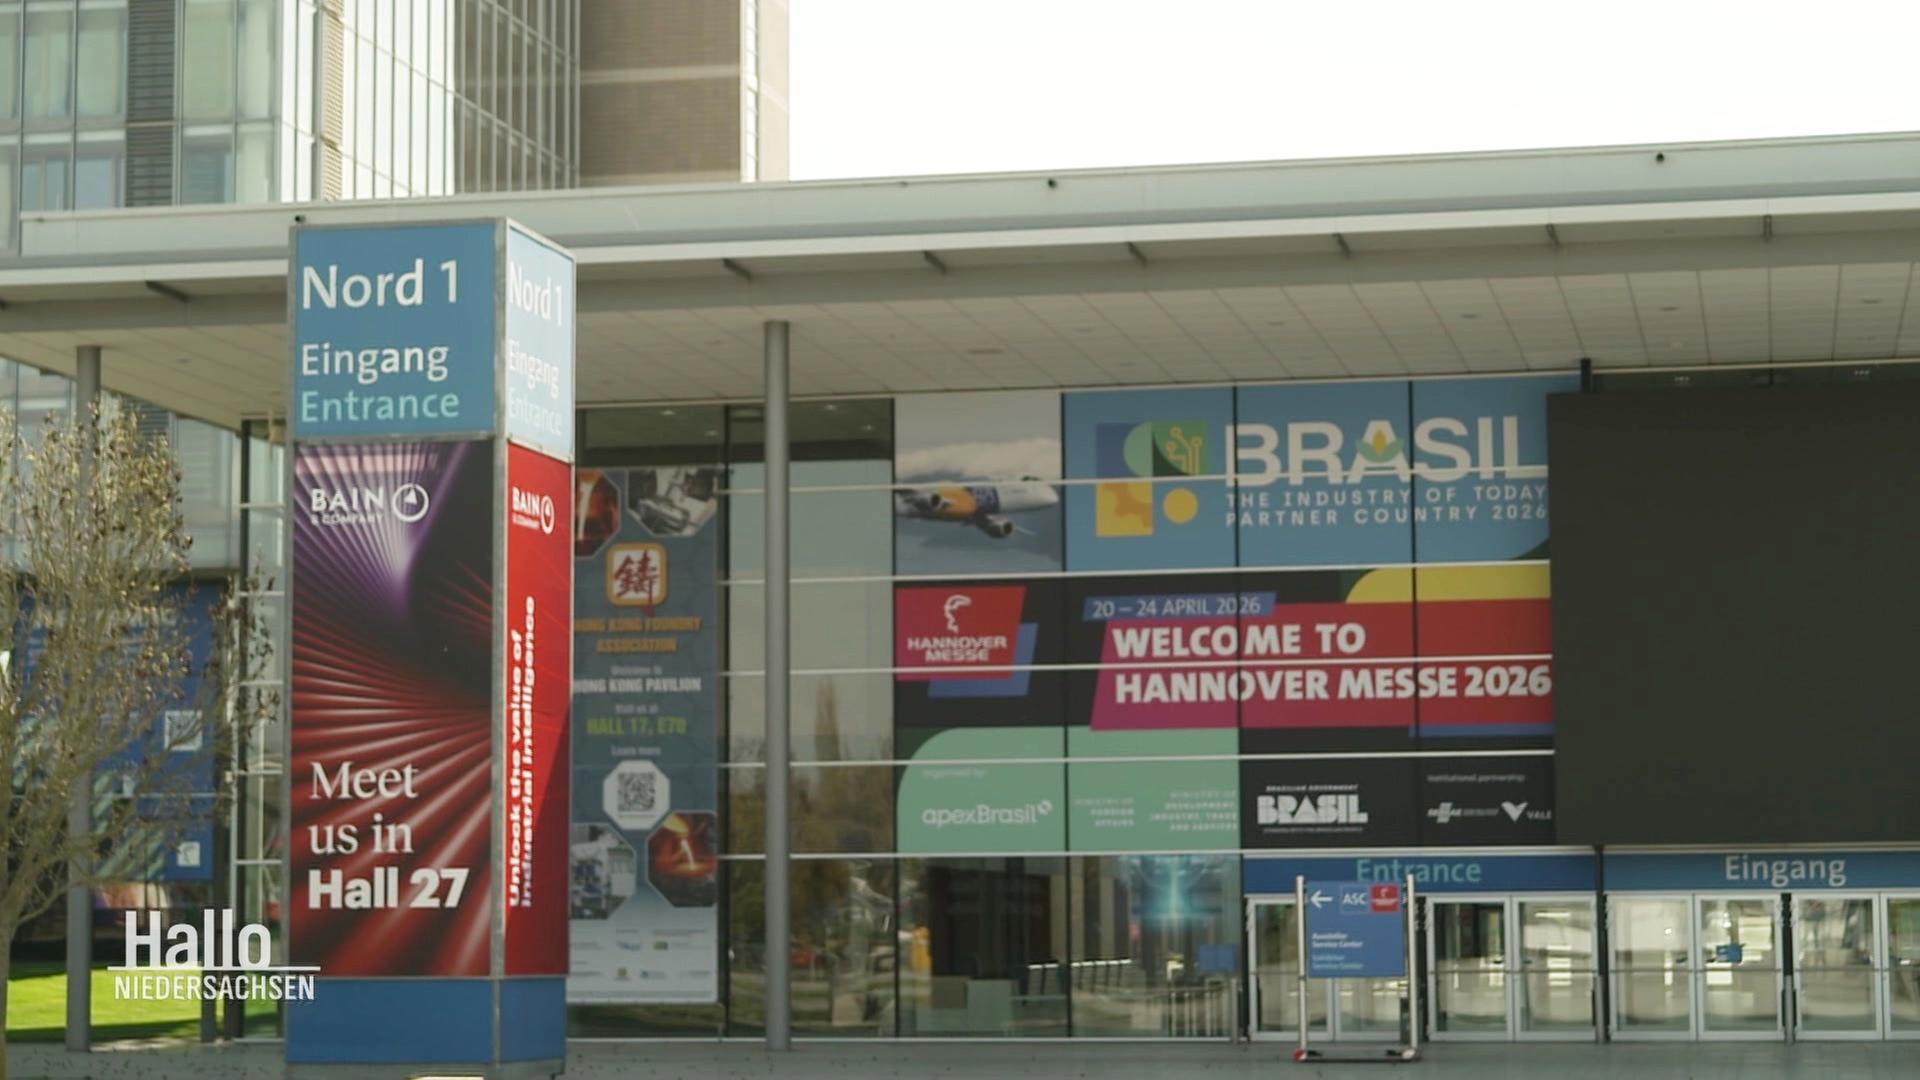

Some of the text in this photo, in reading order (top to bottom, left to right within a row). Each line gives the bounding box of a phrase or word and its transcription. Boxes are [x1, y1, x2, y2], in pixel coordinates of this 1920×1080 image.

[303, 258, 457, 310] Nord 1
[509, 261, 562, 326] Nord 1
[302, 342, 449, 384] Eingang
[509, 339, 559, 400] Eingang
[301, 390, 460, 423] Entrance
[509, 388, 562, 436] Entrance
[1225, 416, 1548, 487] BRASIL
[311, 487, 384, 512] BAIN
[512, 486, 540, 517] BAIN
[1226, 484, 1546, 508] THE INDUSTRY OF TODAY
[322, 512, 384, 526] COMPANY
[1226, 504, 1547, 527] PARTNER COUNTRY 2026
[1092, 600, 1114, 618] 20
[1136, 600, 1157, 617] 24
[1162, 599, 1210, 616] APRIL
[1215, 597, 1261, 615] 2026
[907, 635, 1007, 650] HANNOVER
[925, 649, 989, 662] MESSE
[1111, 623, 1366, 657] WELCOME TO
[521, 596, 535, 765] intelligence
[1115, 665, 1552, 704] HANNOVER MESSE 2026
[587, 719, 624, 735] HALL
[309, 760, 419, 800] Meet
[510, 628, 522, 907] Unlock the value of
[921, 804, 1038, 828] apexBrasil
[1257, 794, 1368, 825] BRASIL
[1527, 810, 1552, 819] VALE
[308, 812, 414, 855] us in
[1356, 859, 1482, 884] Entrance
[1724, 855, 1847, 888] Eingang
[308, 867, 470, 910] Hall 27
[1342, 893, 1367, 905] ASC
